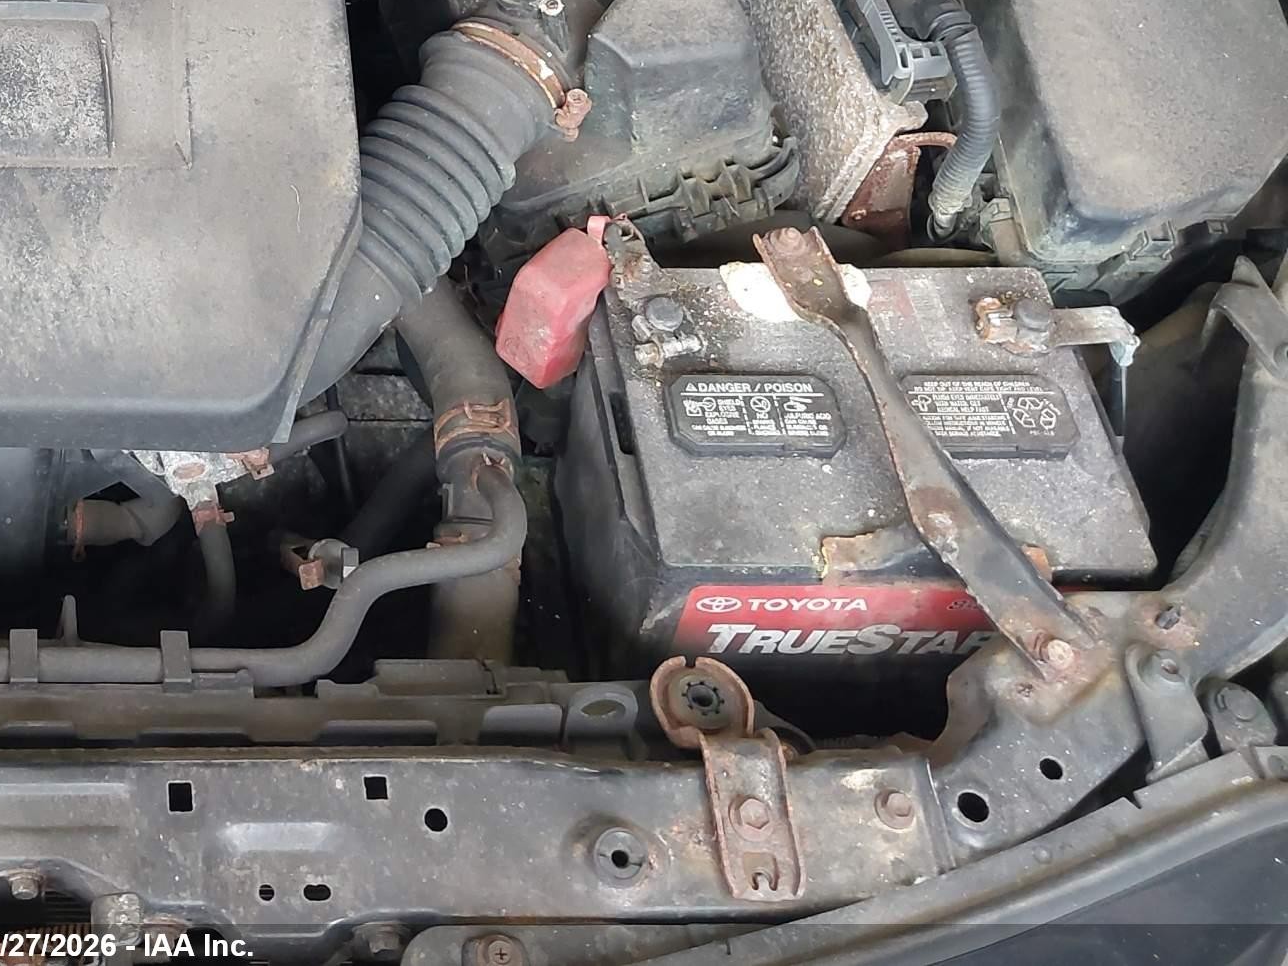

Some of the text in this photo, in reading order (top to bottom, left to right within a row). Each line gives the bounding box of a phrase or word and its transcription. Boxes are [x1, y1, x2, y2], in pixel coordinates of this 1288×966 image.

[698, 383, 814, 392] DANGER / POISON
[748, 599, 868, 611] TOYOTA
